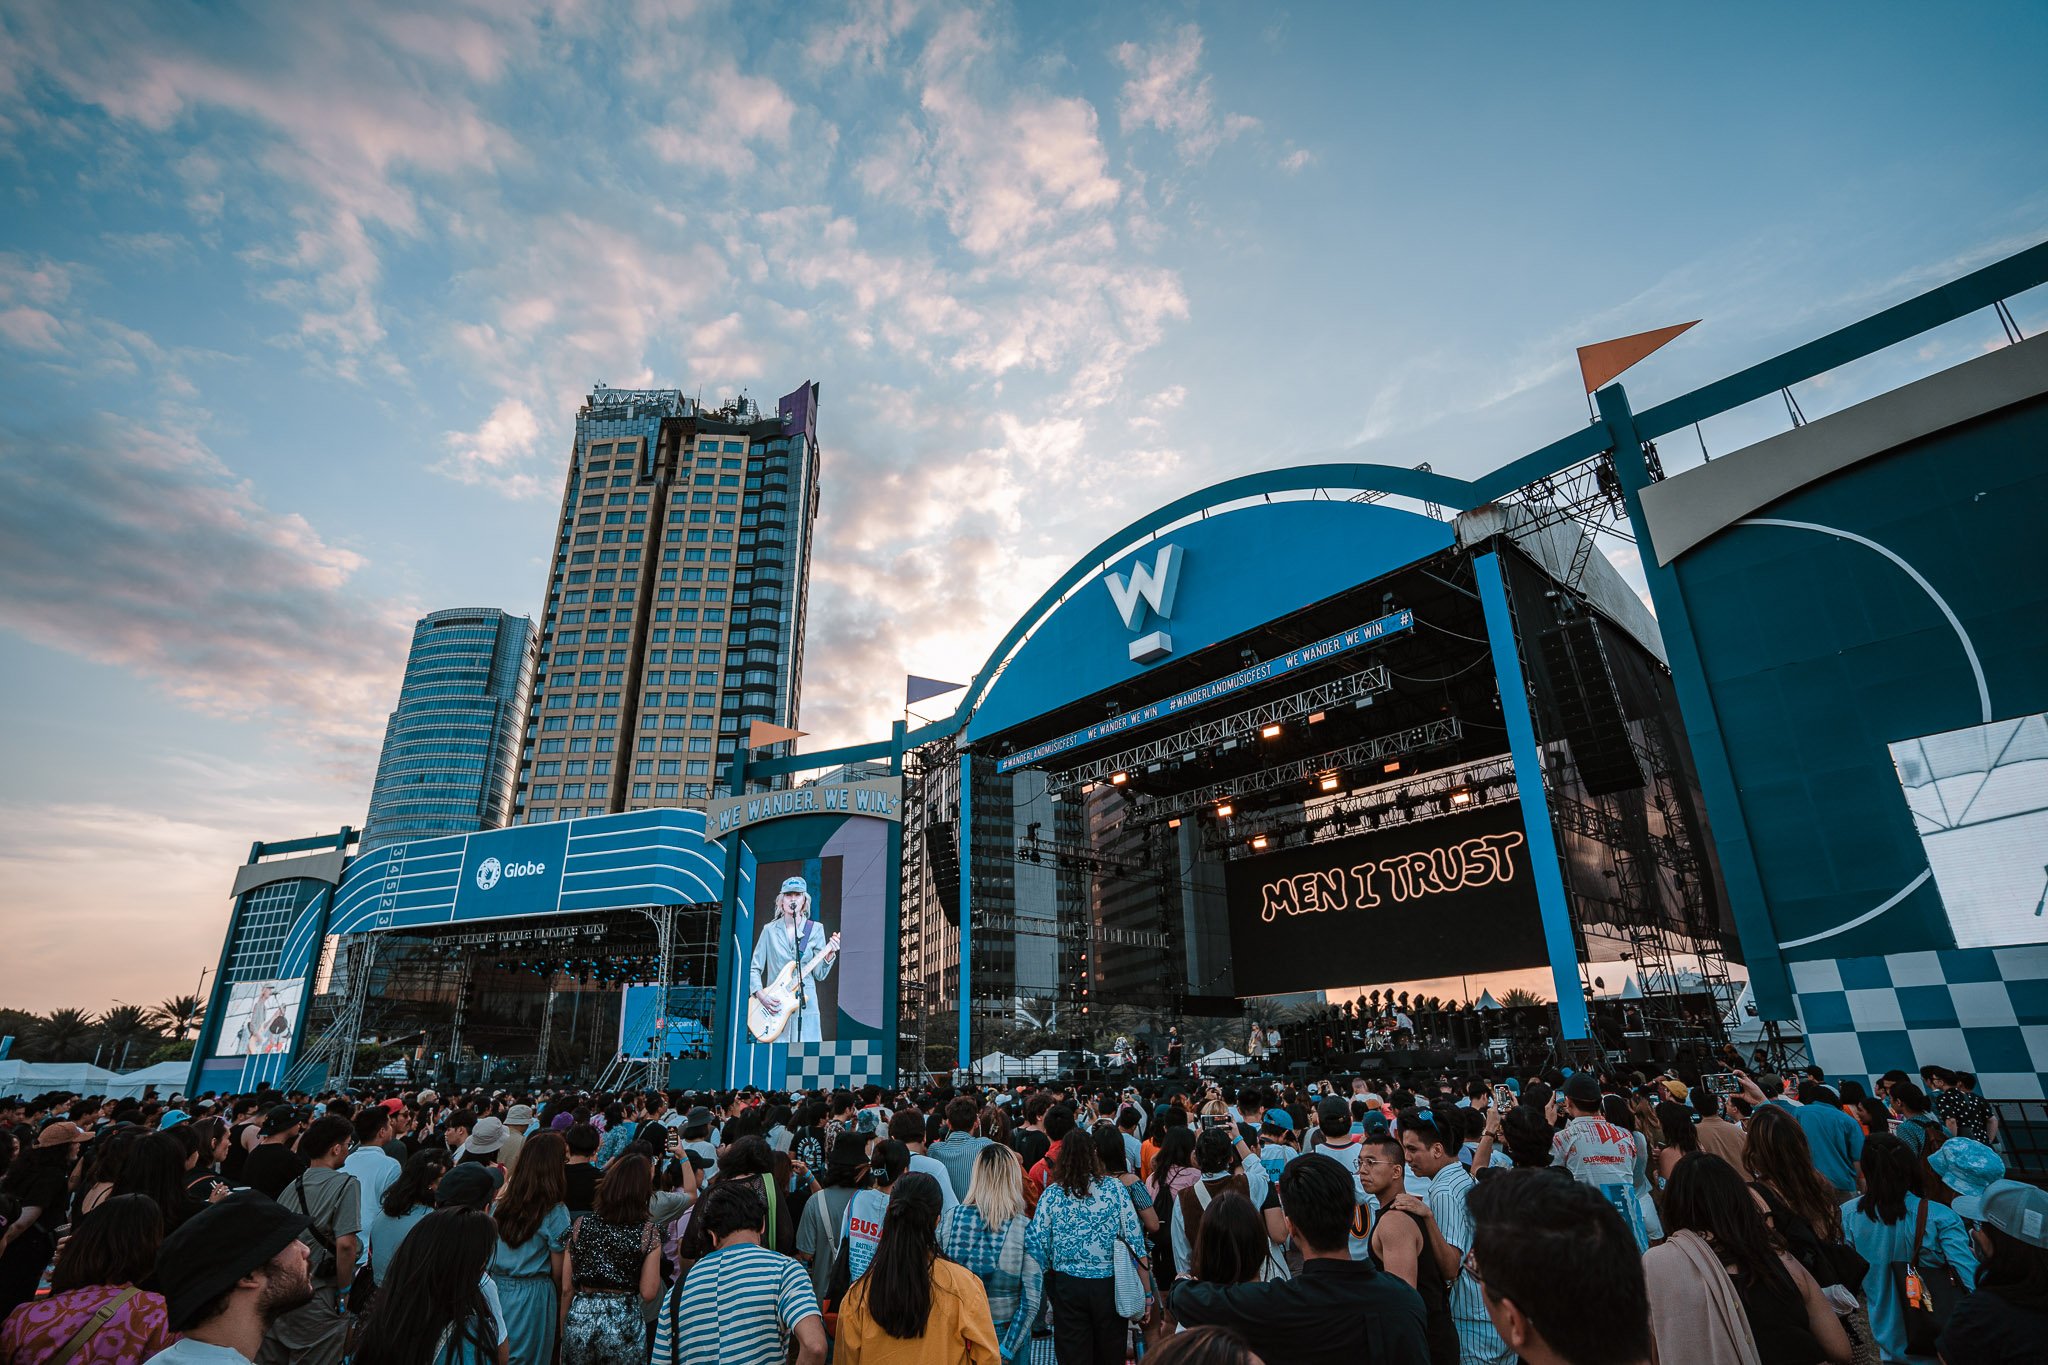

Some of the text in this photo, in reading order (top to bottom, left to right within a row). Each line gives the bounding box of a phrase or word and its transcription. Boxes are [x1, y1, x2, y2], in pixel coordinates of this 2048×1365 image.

[1002, 735, 1078, 769] #WANDERLANDMUSICFEST
[1087, 727, 1097, 740] WE
[1130, 712, 1141, 725] WE
[1169, 664, 1272, 710] #WANDERLANDMUSICFEST
[1285, 655, 1300, 669] WE
[1345, 630, 1360, 646] WE
[719, 788, 892, 831] WE WANDER. WE WIN.
[504, 861, 546, 878] Globe
[1261, 831, 1524, 922] MEN I TRUST
